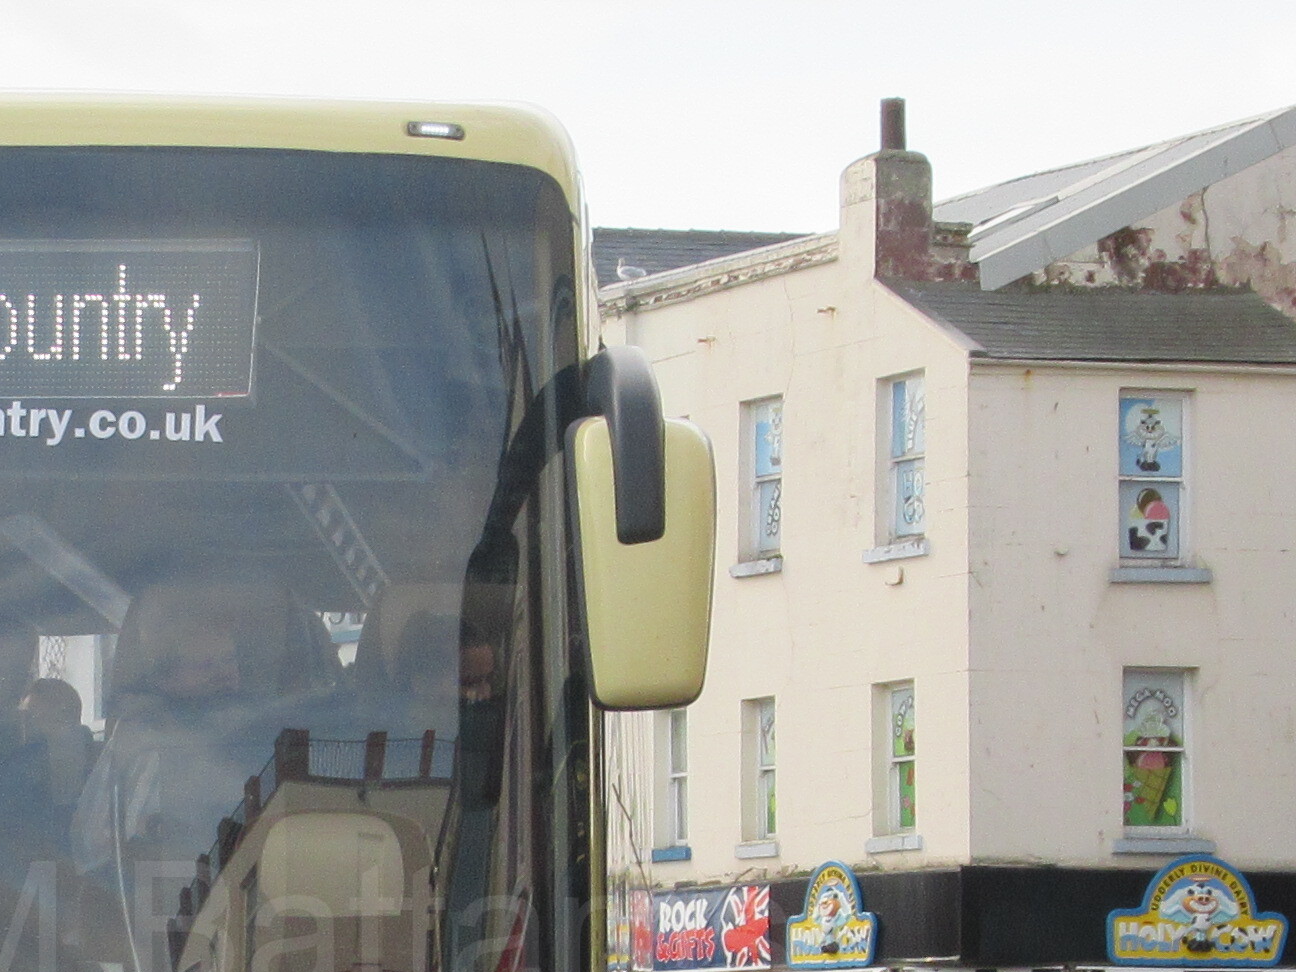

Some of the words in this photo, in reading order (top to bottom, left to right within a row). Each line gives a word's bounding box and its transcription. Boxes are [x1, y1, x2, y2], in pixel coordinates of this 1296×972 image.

[1190, 863, 1228, 881] DIVINE
[1228, 880, 1250, 916] DAIRY
[659, 897, 709, 934] ROCK
[1119, 921, 1189, 952] HOLY
[1214, 924, 1279, 953] COW
